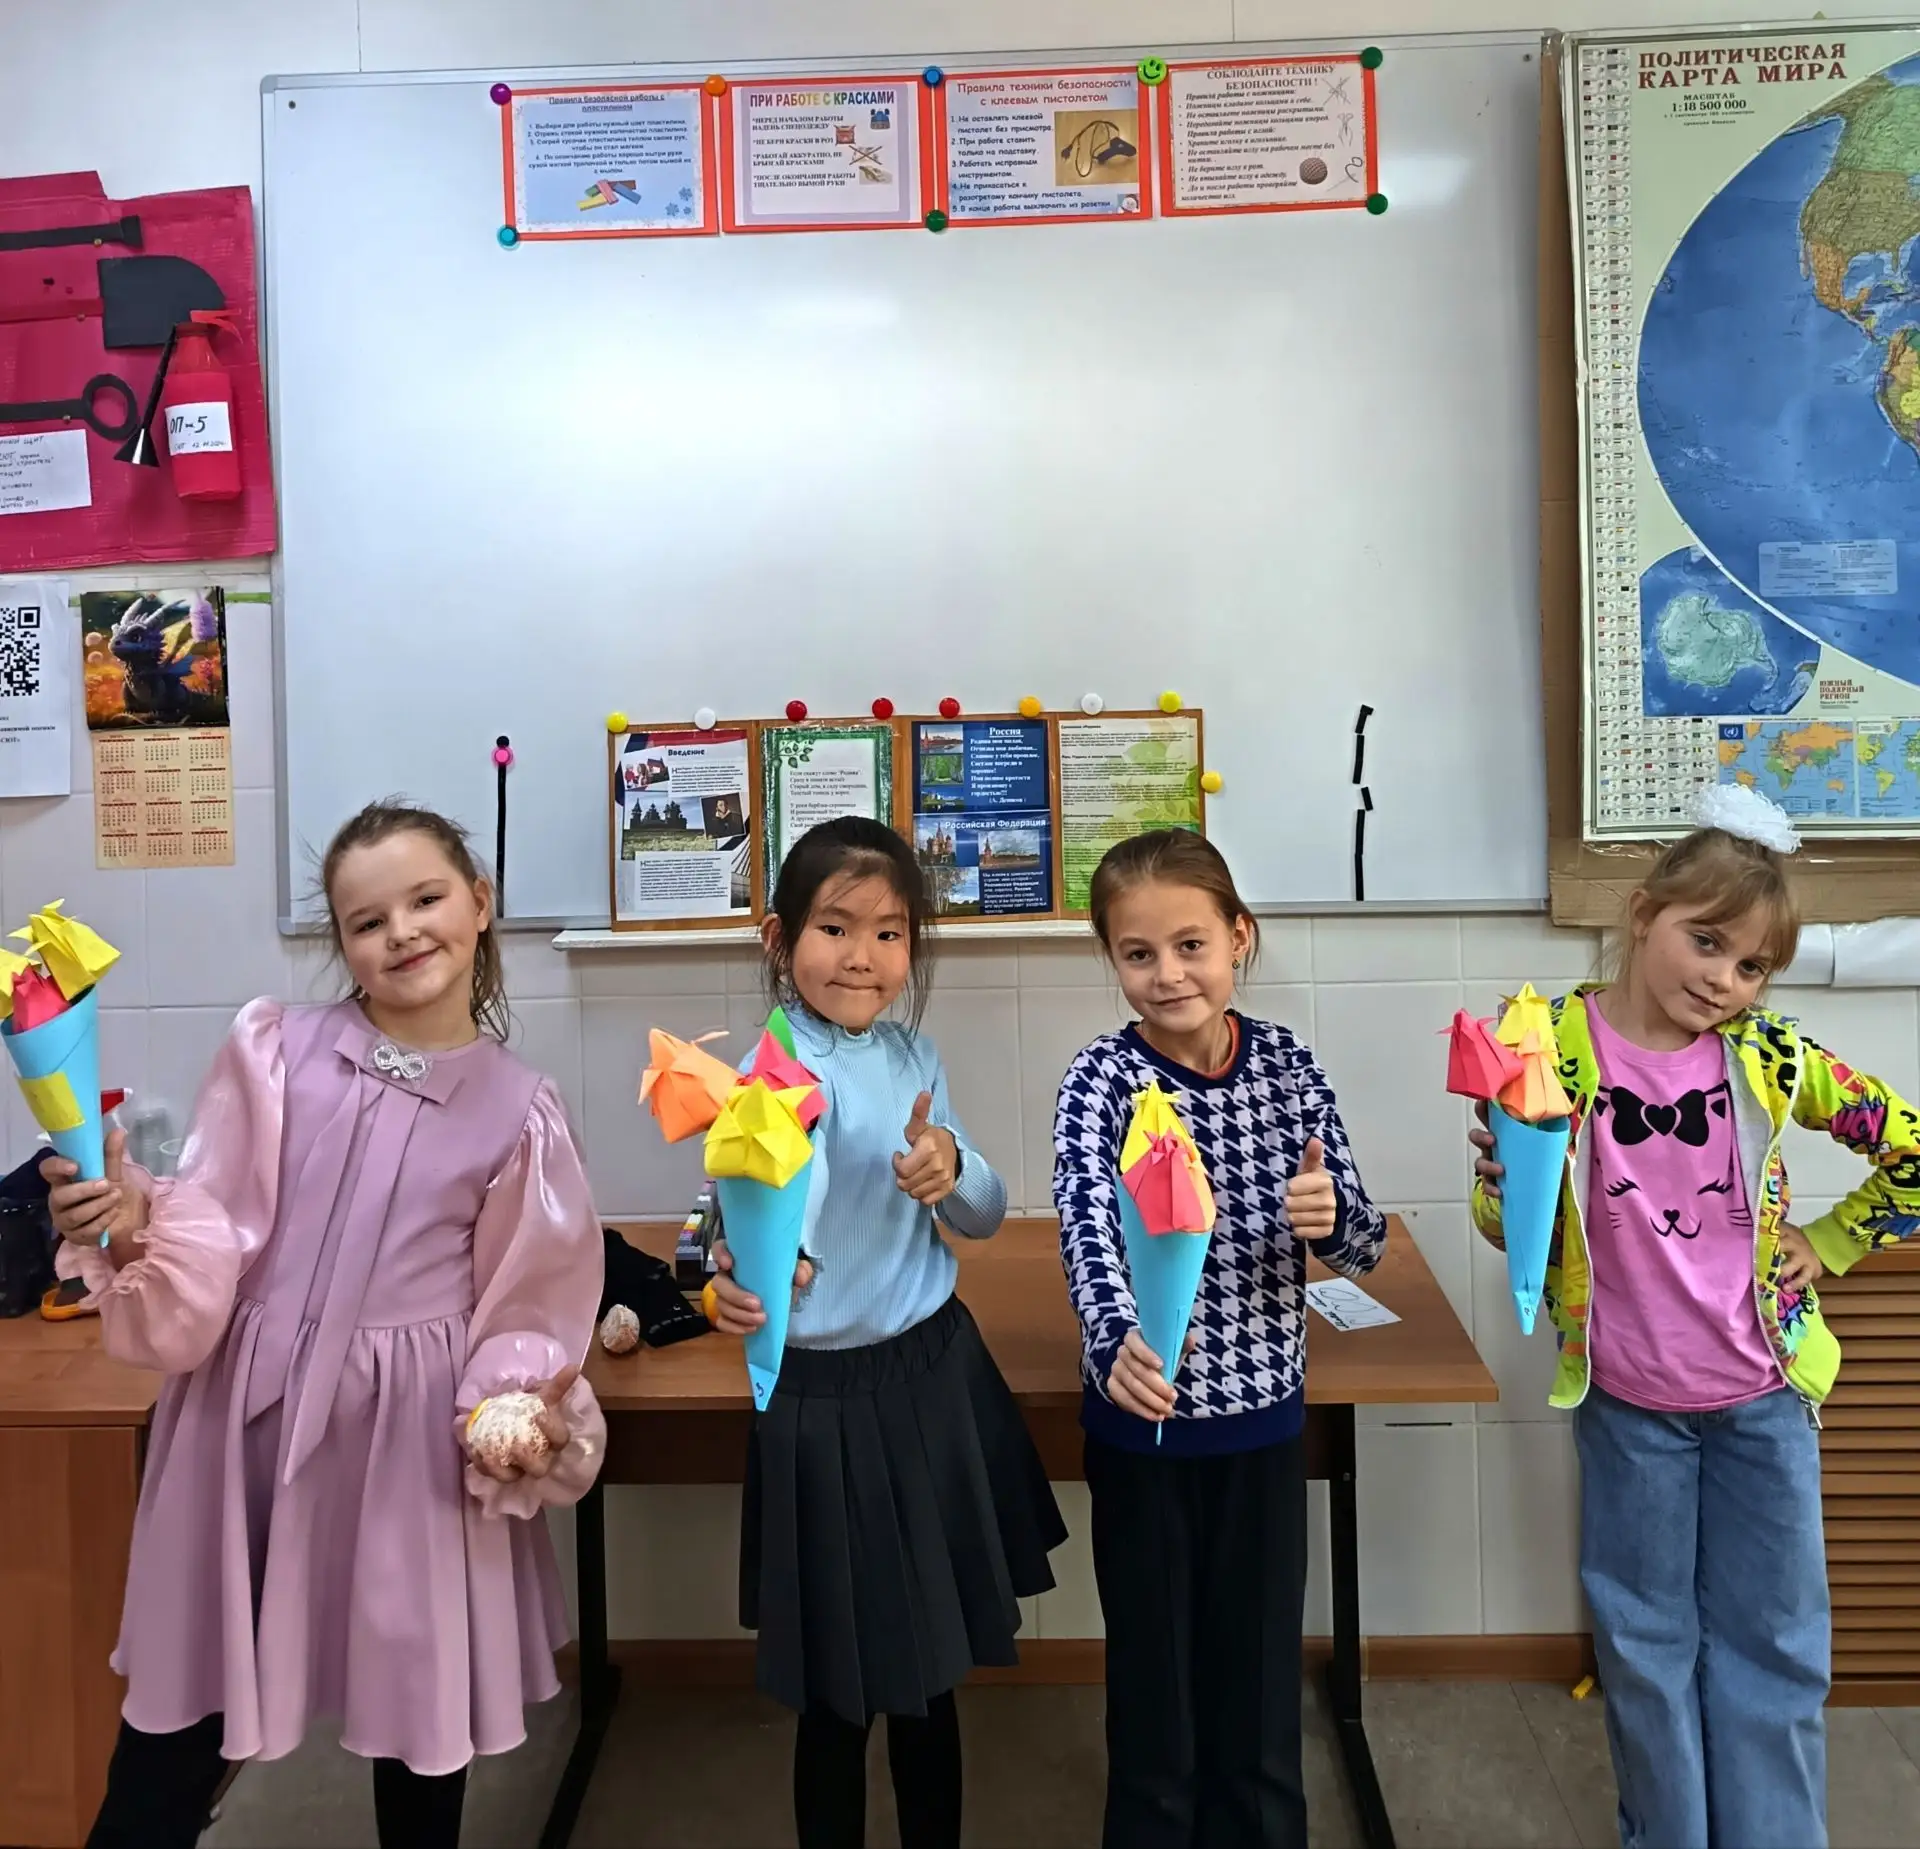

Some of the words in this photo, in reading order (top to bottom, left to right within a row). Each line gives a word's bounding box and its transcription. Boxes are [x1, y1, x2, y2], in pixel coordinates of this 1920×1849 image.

[1639, 43, 1846, 68] ПОЛИТИЧЕСКАЯ
[1207, 67, 1282, 79] СОБЛЮДАЙТЕ
[1286, 65, 1334, 75] ТЕХНИКУ
[1638, 67, 1742, 89] КАРТА
[1757, 62, 1847, 83] МИРА
[957, 83, 1004, 94] Правила
[1010, 81, 1053, 92] техники
[1058, 79, 1131, 89] безопасности
[1226, 80, 1312, 90] БЕЗОПАСНОСТИ
[750, 95, 773, 107] ПРИ
[776, 93, 821, 106] РАБОТЕ
[823, 92, 831, 105] С
[834, 91, 894, 103] КРАСКАМИ
[1044, 94, 1108, 104] пистолетом
[1684, 92, 1735, 101] МАСШТАБ
[1673, 102, 1696, 112] 1:18
[1700, 101, 1721, 110] 500
[1724, 100, 1746, 109] 000
[170, 415, 208, 434] ОП-5
[989, 727, 1021, 736] Россия
[945, 821, 995, 829] Российская
[997, 819, 1046, 828] Федерация
